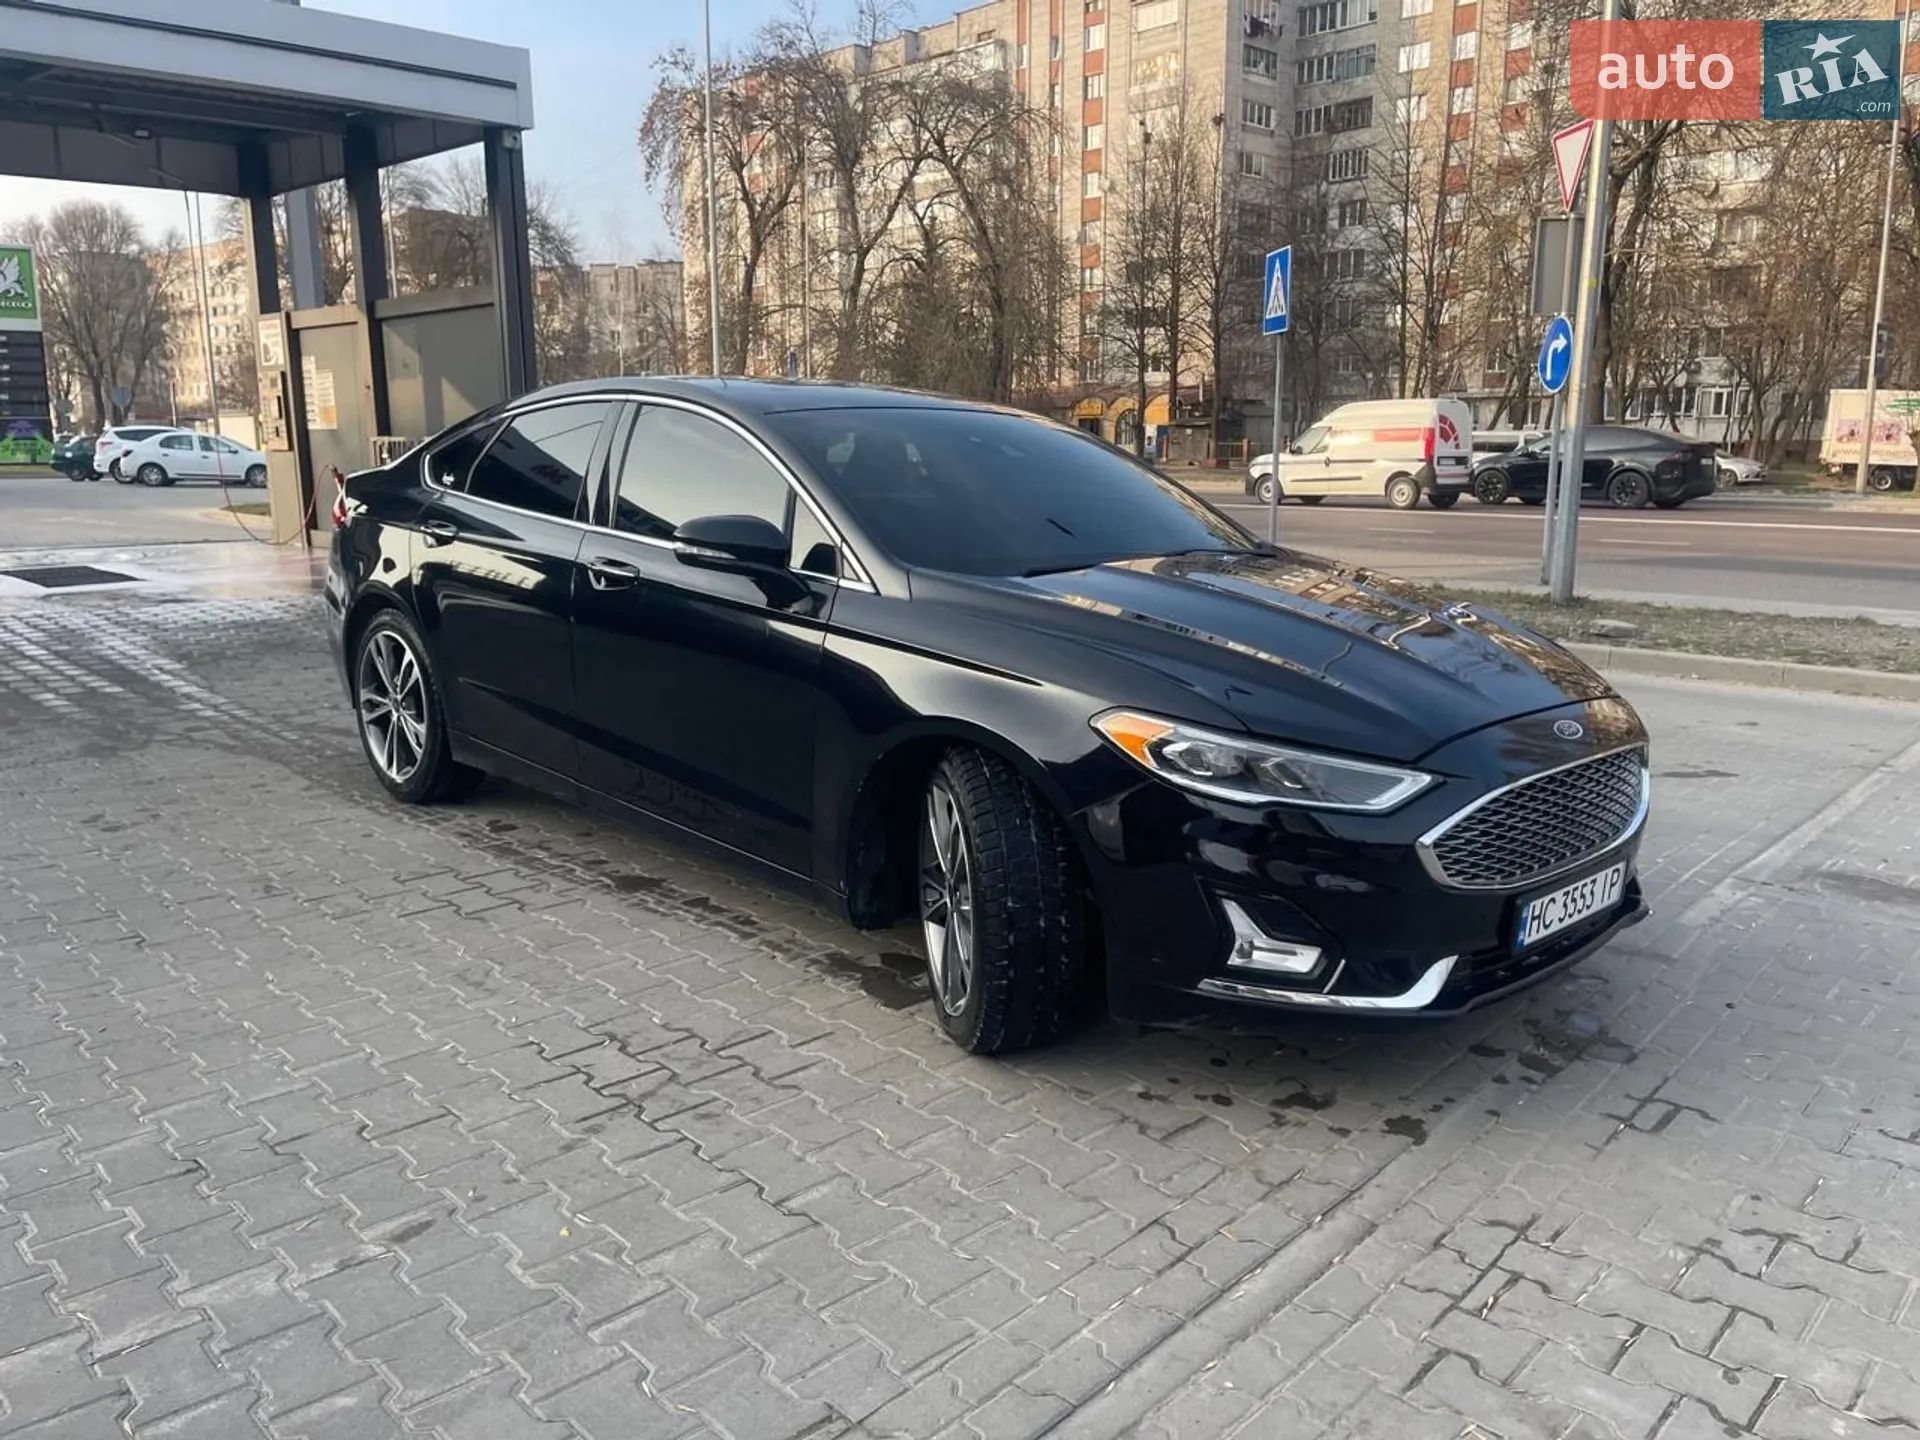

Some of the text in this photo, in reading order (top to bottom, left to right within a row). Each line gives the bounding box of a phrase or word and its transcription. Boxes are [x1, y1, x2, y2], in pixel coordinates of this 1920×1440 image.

[1527, 867, 1620, 938] HC 3553 IP
